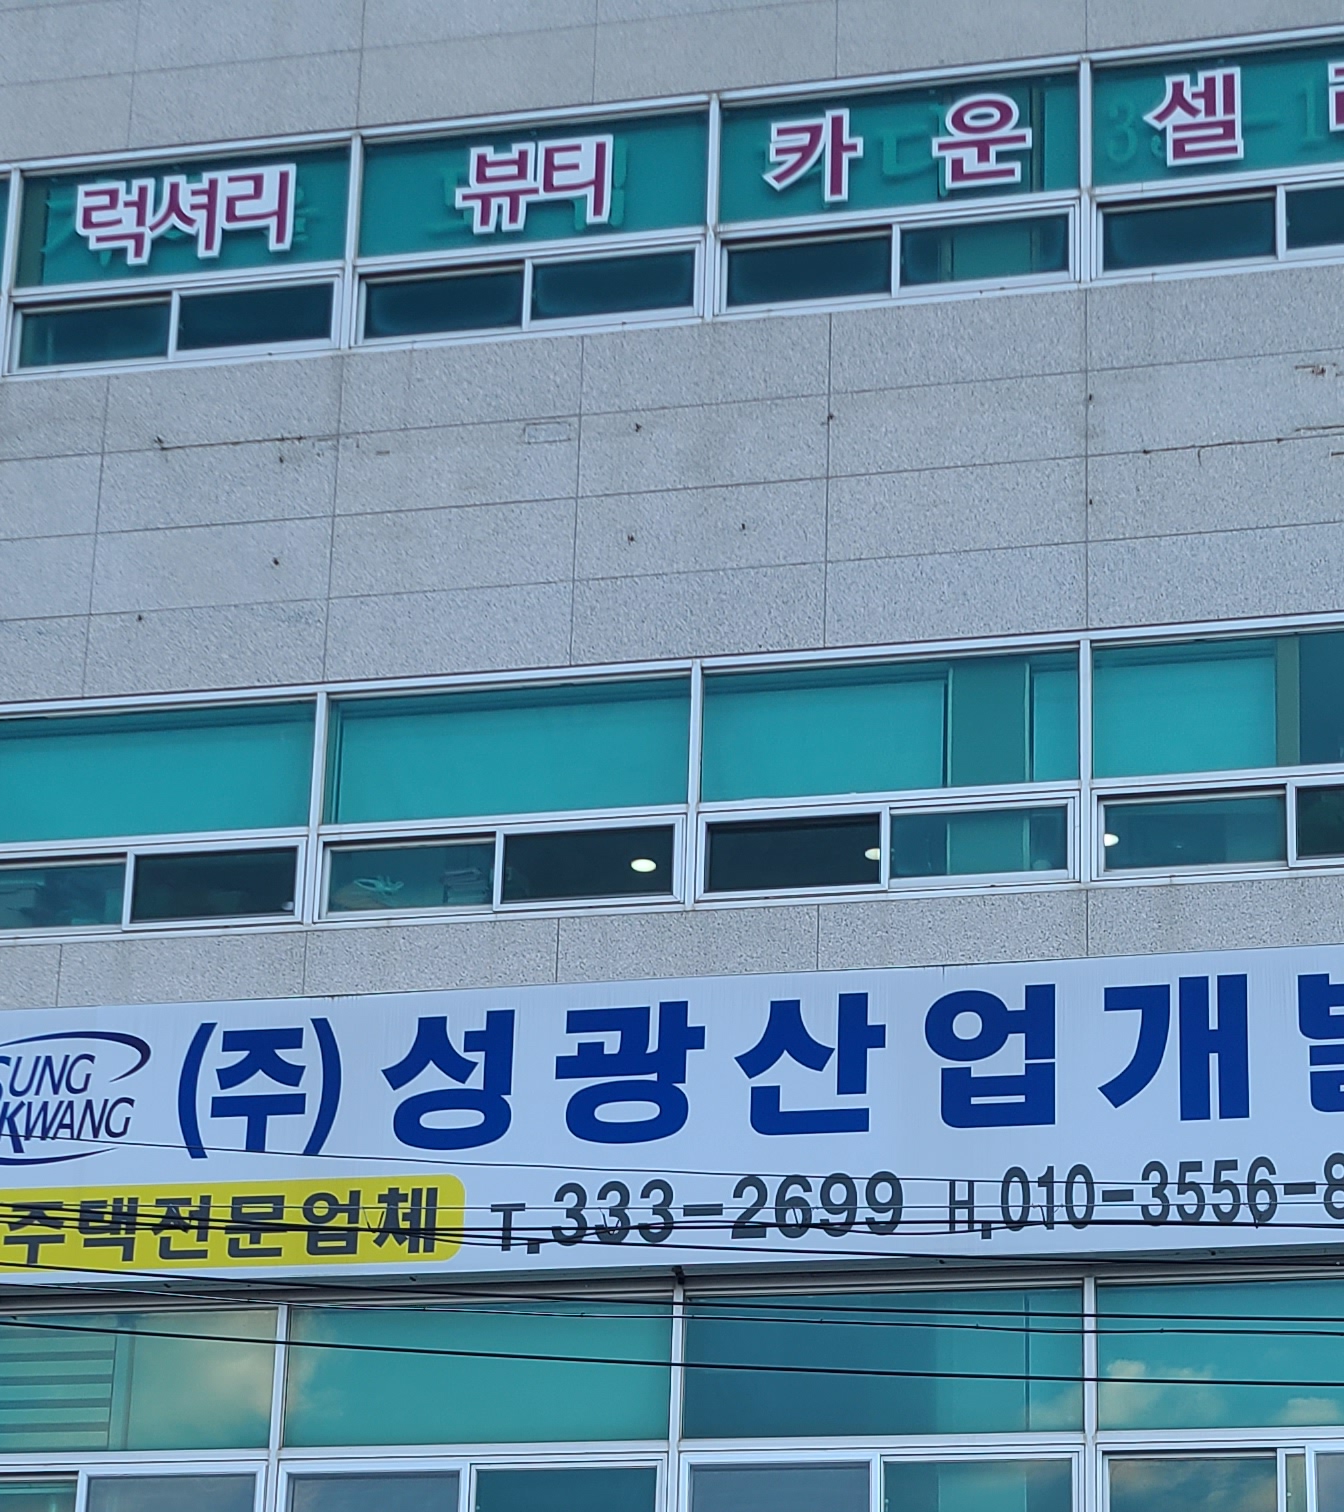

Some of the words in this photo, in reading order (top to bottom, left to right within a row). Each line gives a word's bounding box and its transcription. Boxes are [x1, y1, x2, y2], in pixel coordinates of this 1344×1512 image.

[76, 162, 297, 266] 럭셔리
[459, 134, 614, 234] 뷰티
[177, 1017, 343, 1159] (주)
[2, 1186, 440, 1266] 주택전문업체
